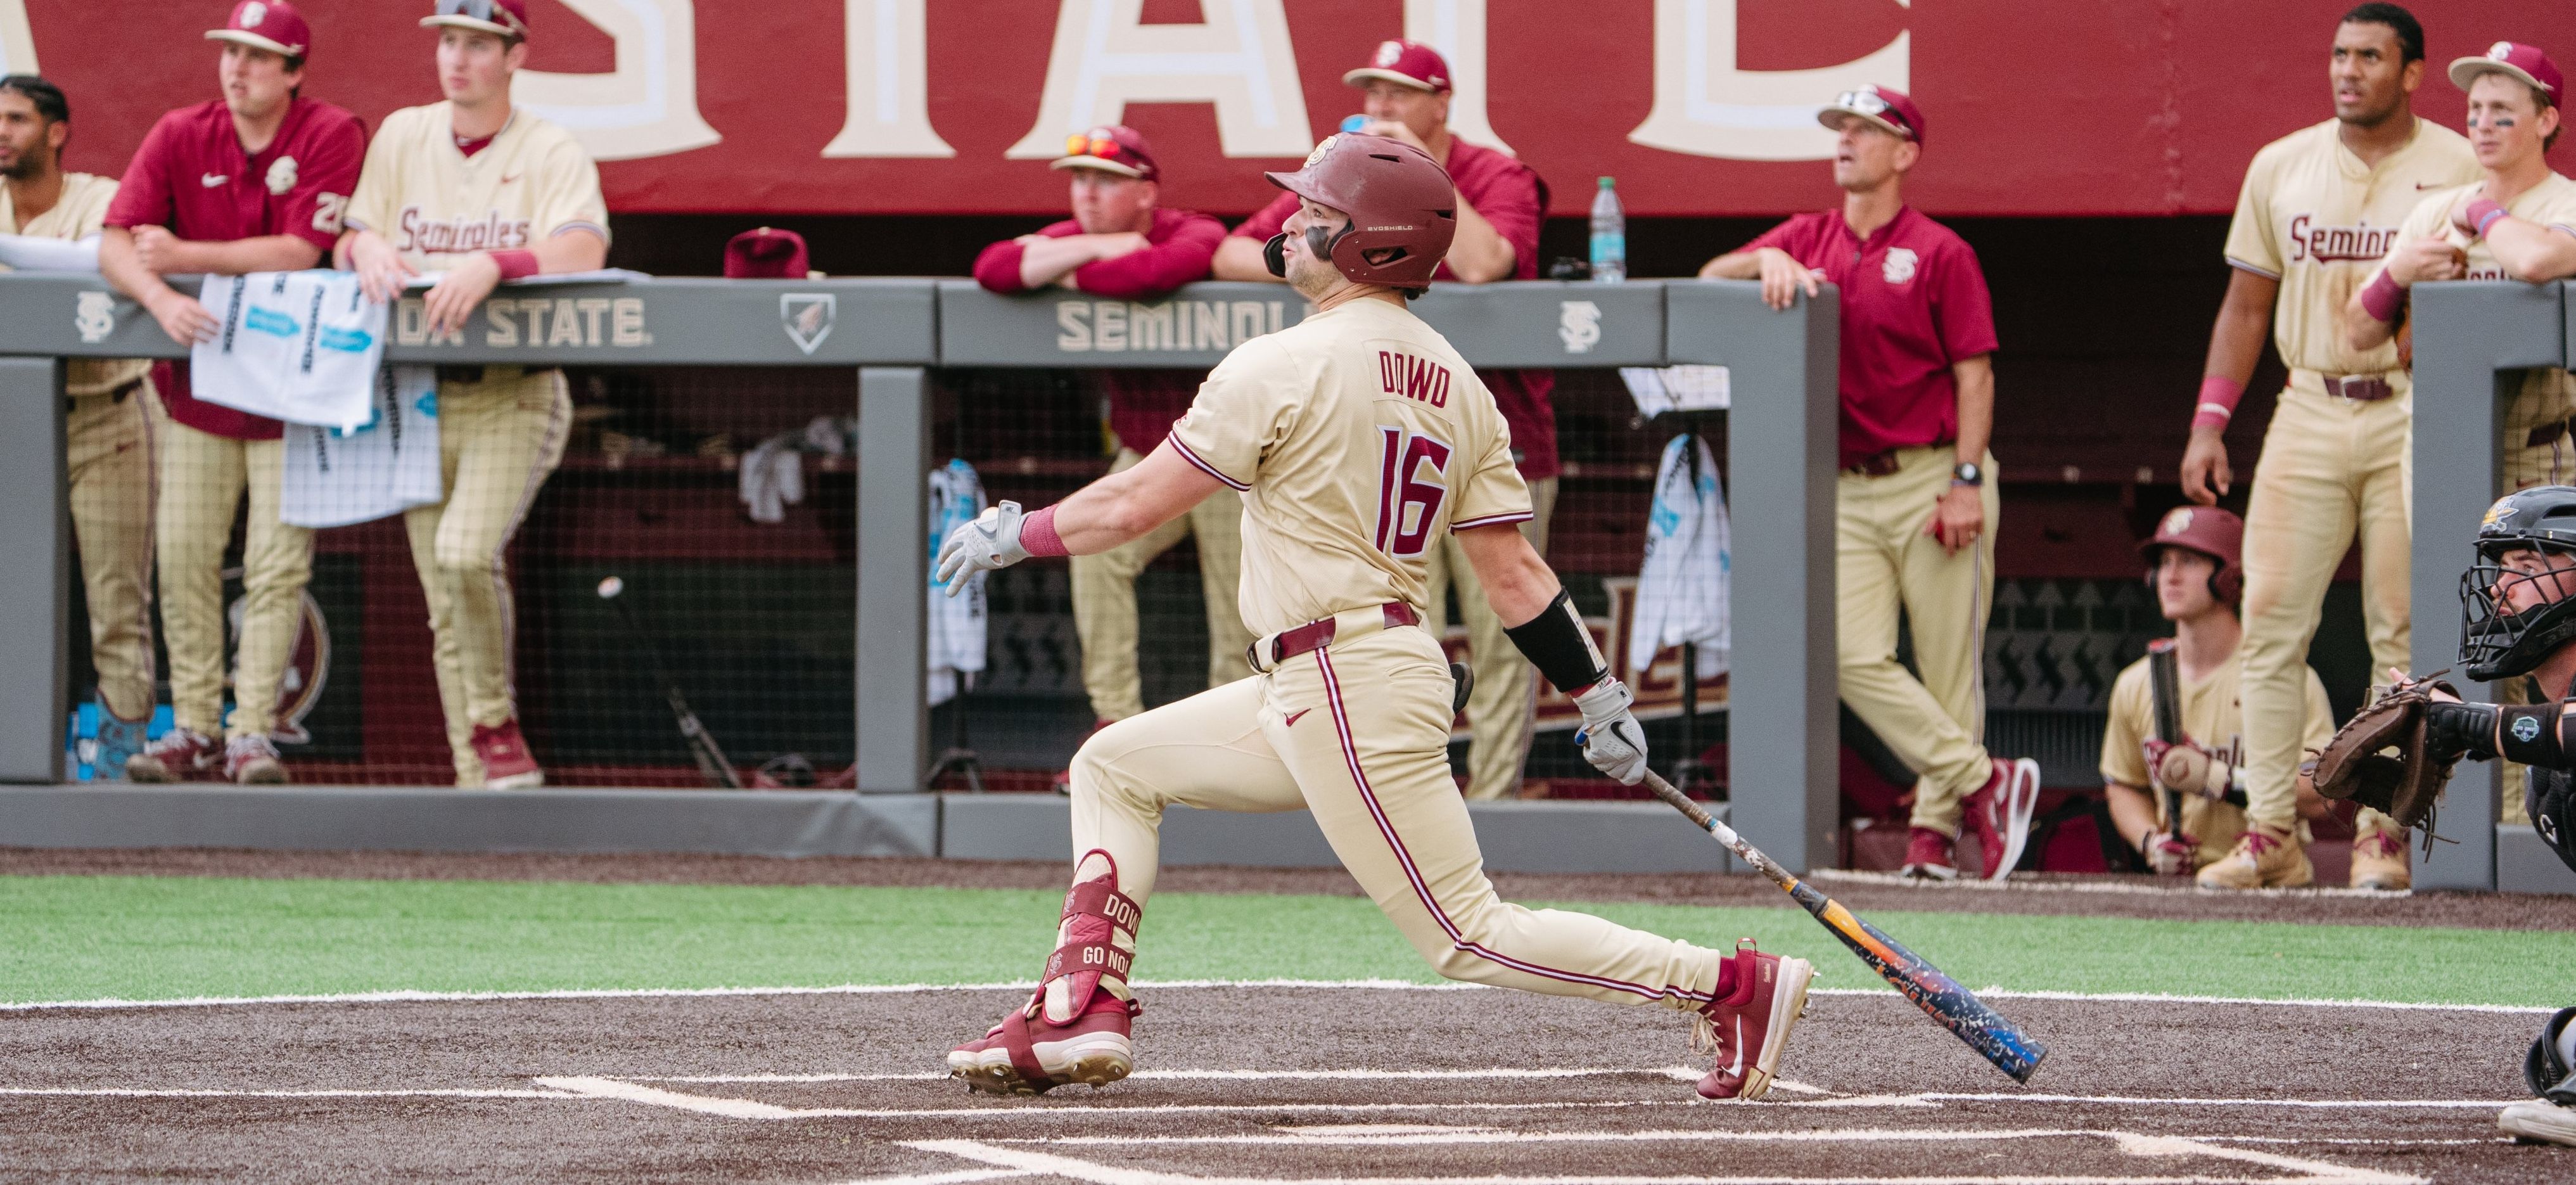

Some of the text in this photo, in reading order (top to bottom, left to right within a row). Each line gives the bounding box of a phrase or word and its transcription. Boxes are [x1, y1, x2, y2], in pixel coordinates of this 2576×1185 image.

[1379, 351, 1450, 408] DOWD
[1375, 424, 1455, 559] 16
[1083, 947, 1104, 964] GO
